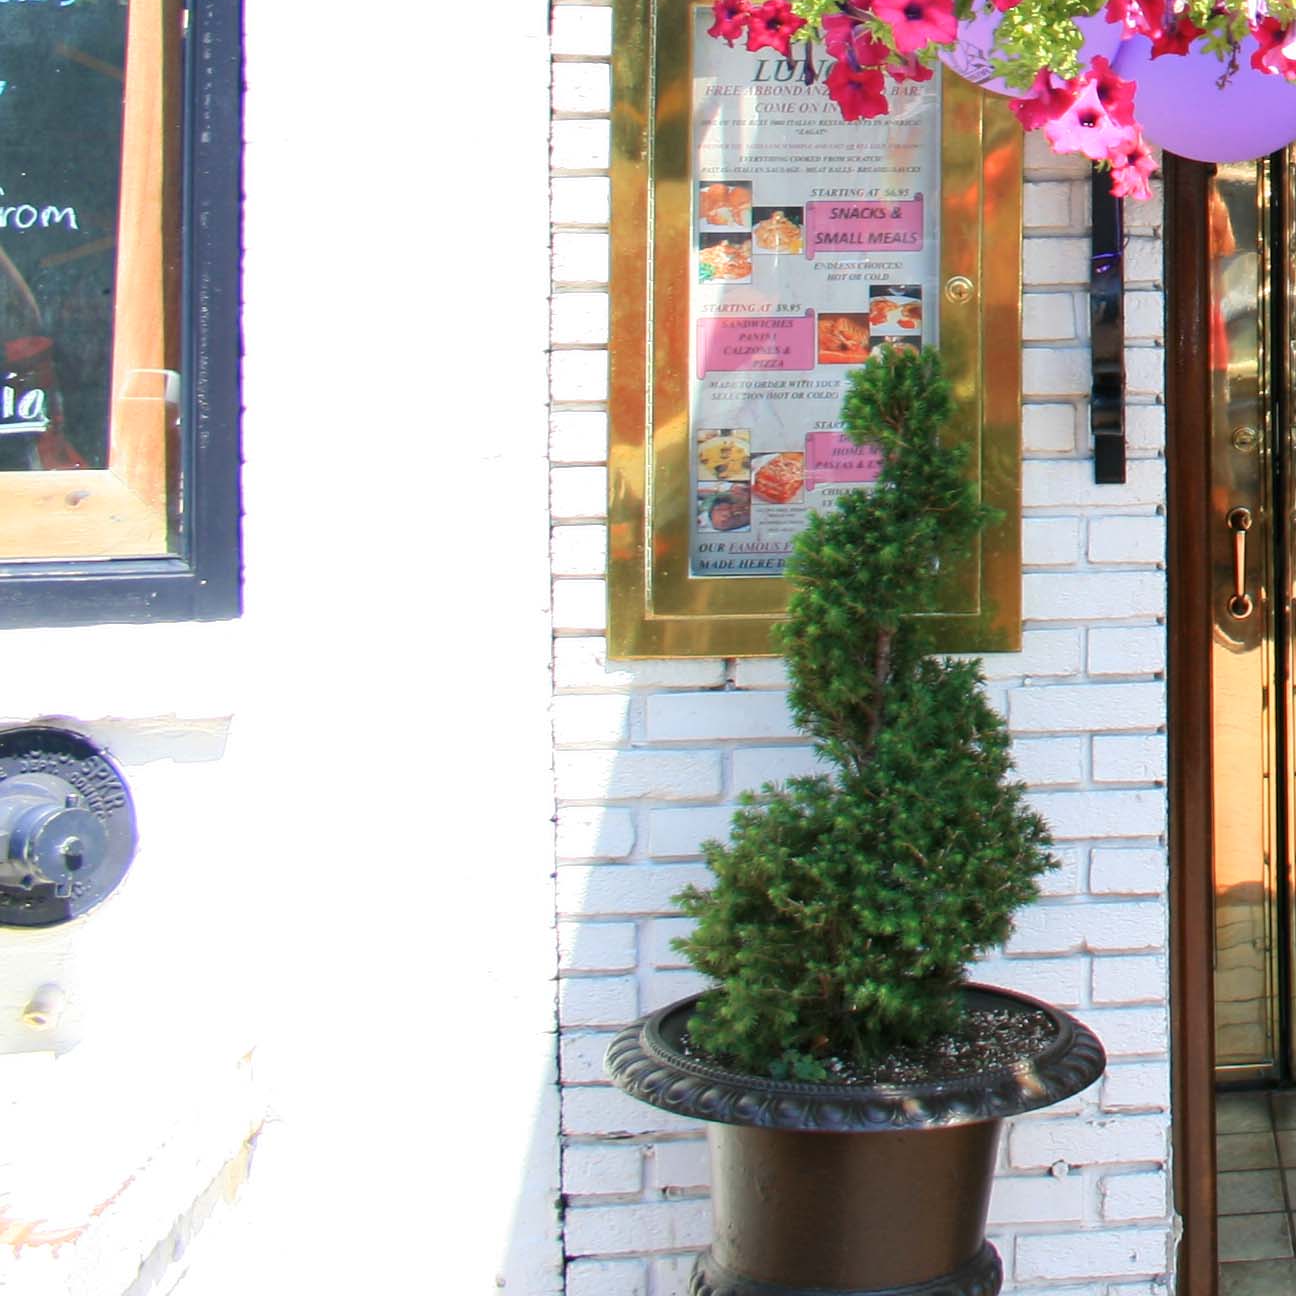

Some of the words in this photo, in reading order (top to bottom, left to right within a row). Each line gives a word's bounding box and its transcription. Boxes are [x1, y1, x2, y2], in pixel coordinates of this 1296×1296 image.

[747, 85, 831, 97] ABBONDANZ
[755, 103, 797, 114] COME
[810, 188, 864, 198] STARTING
[0, 204, 79, 230] rom
[829, 207, 887, 220] SNACKS
[890, 207, 903, 220] &
[814, 232, 864, 245] SMALL
[867, 232, 919, 245] MEALS
[702, 304, 756, 313] STARTING
[721, 319, 794, 329] SANDWICHES
[751, 358, 785, 369] PIZZA
[698, 543, 726, 553] OUR
[698, 560, 737, 569] MADE
[738, 559, 774, 569] HERE
